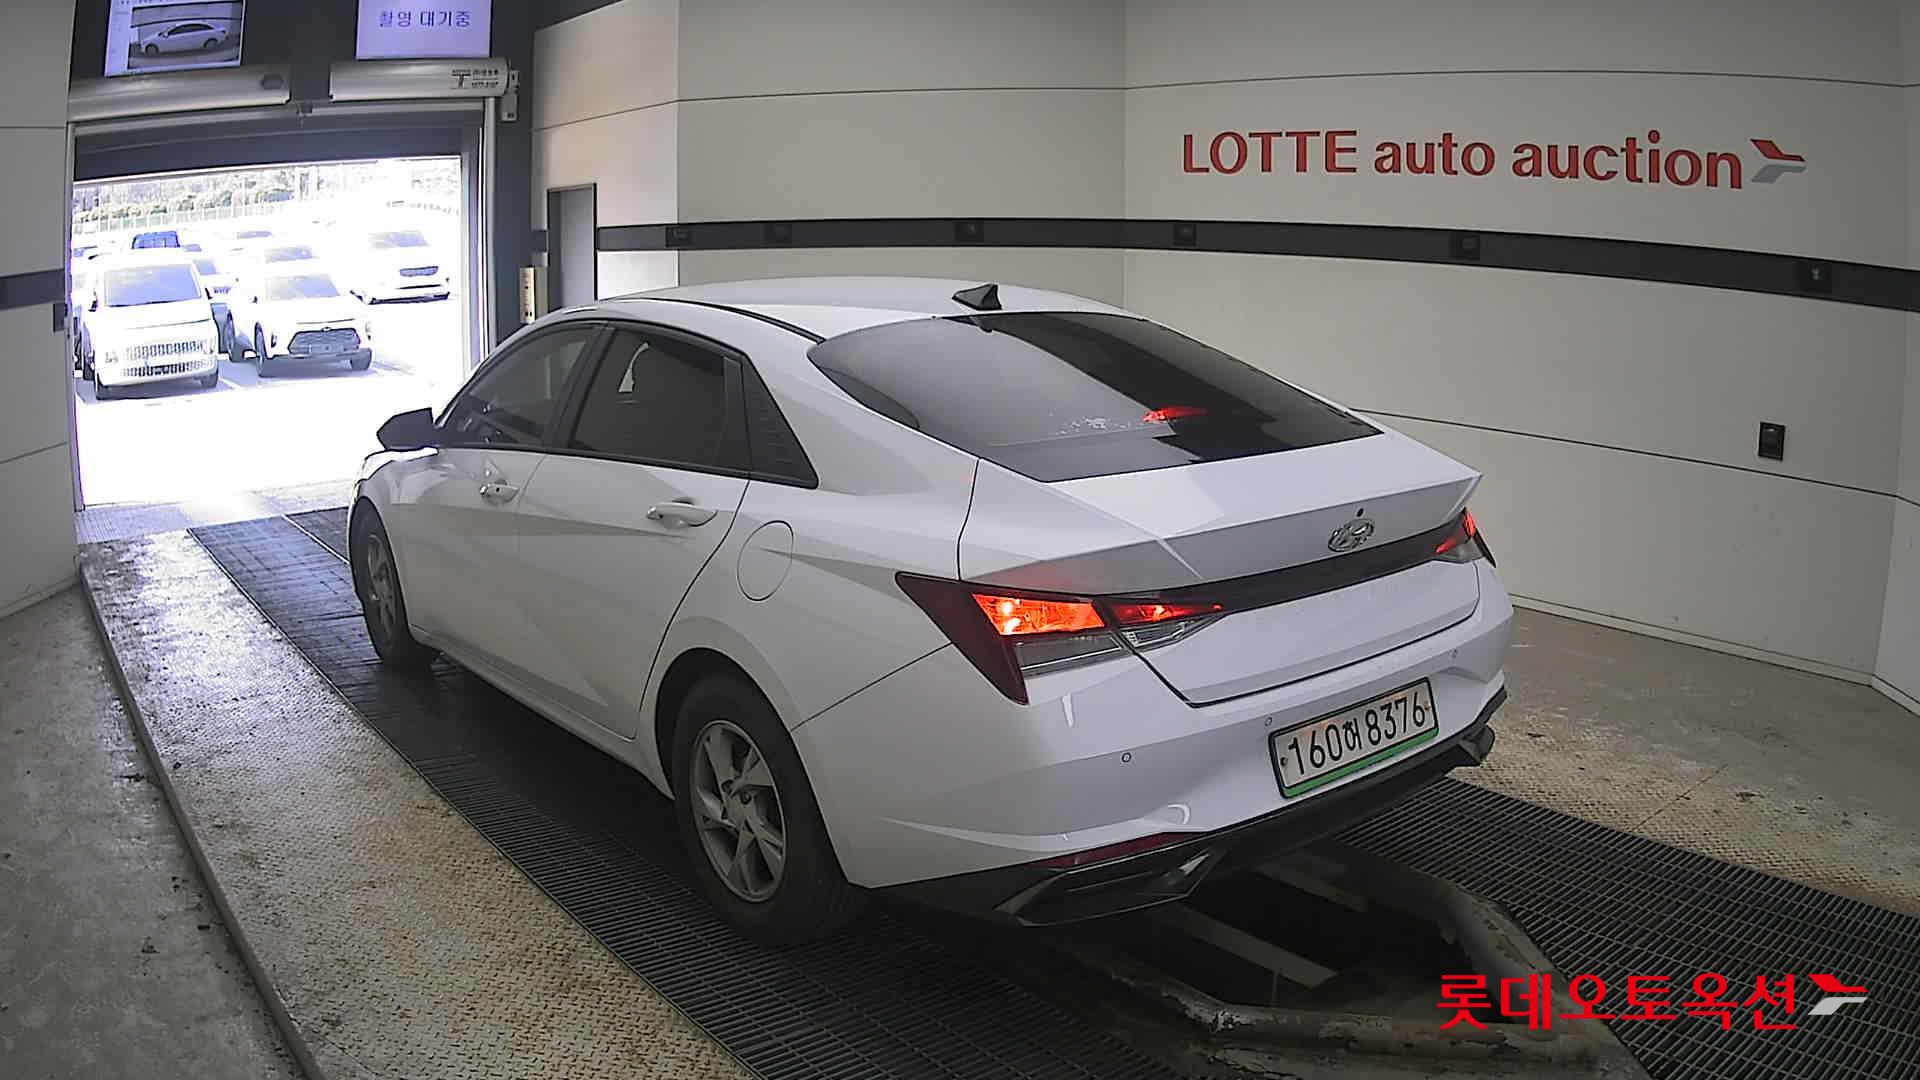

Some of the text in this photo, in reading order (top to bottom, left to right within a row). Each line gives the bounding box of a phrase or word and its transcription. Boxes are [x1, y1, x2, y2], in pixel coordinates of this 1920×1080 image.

[420, 10, 472, 29] 대기중
[1183, 130, 1743, 190] LOTTE auto auction
